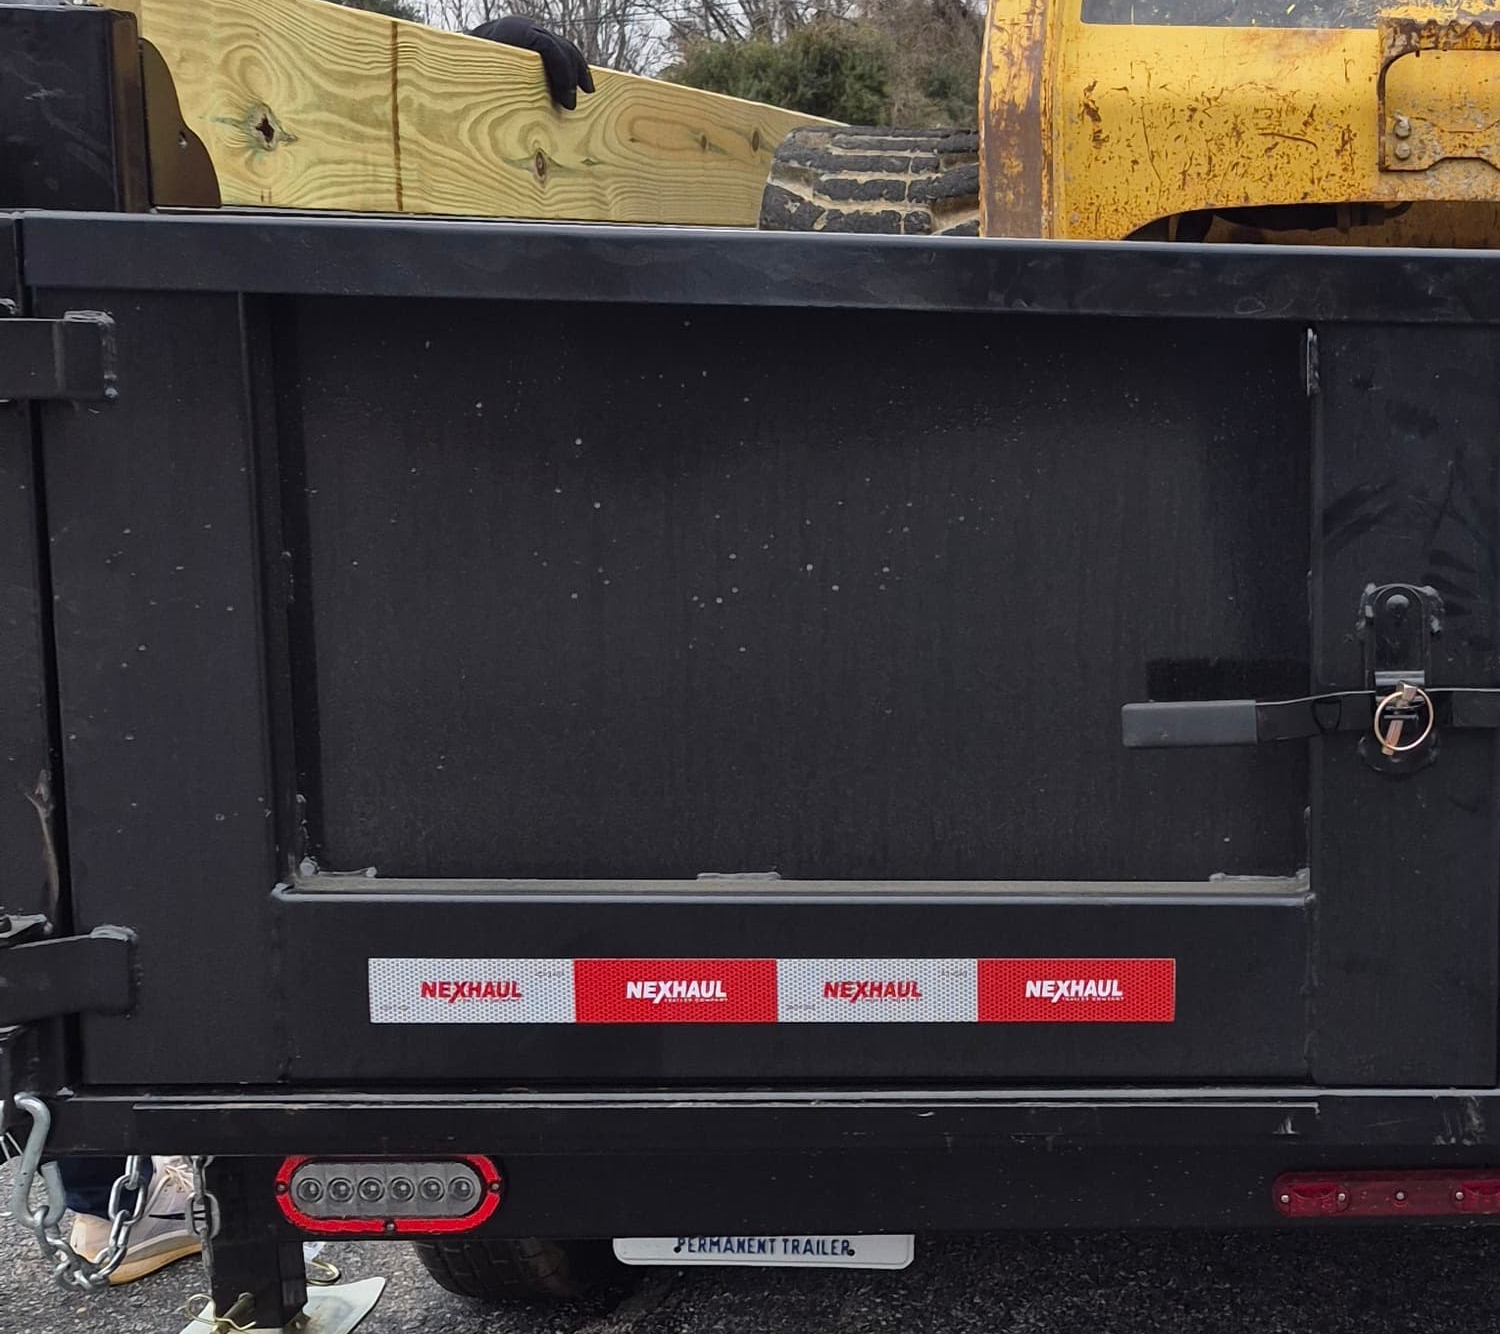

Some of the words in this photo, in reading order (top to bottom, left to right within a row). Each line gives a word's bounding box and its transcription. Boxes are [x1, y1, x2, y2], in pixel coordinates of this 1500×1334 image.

[420, 981, 522, 1003] NEXHAUL
[626, 980, 727, 1004] NEXHAUL
[823, 981, 922, 1003] NEXHAUL
[1025, 979, 1123, 1003] NEXHAUL
[677, 1236, 776, 1255] PERMANENT
[782, 1238, 851, 1256] TRAILER
